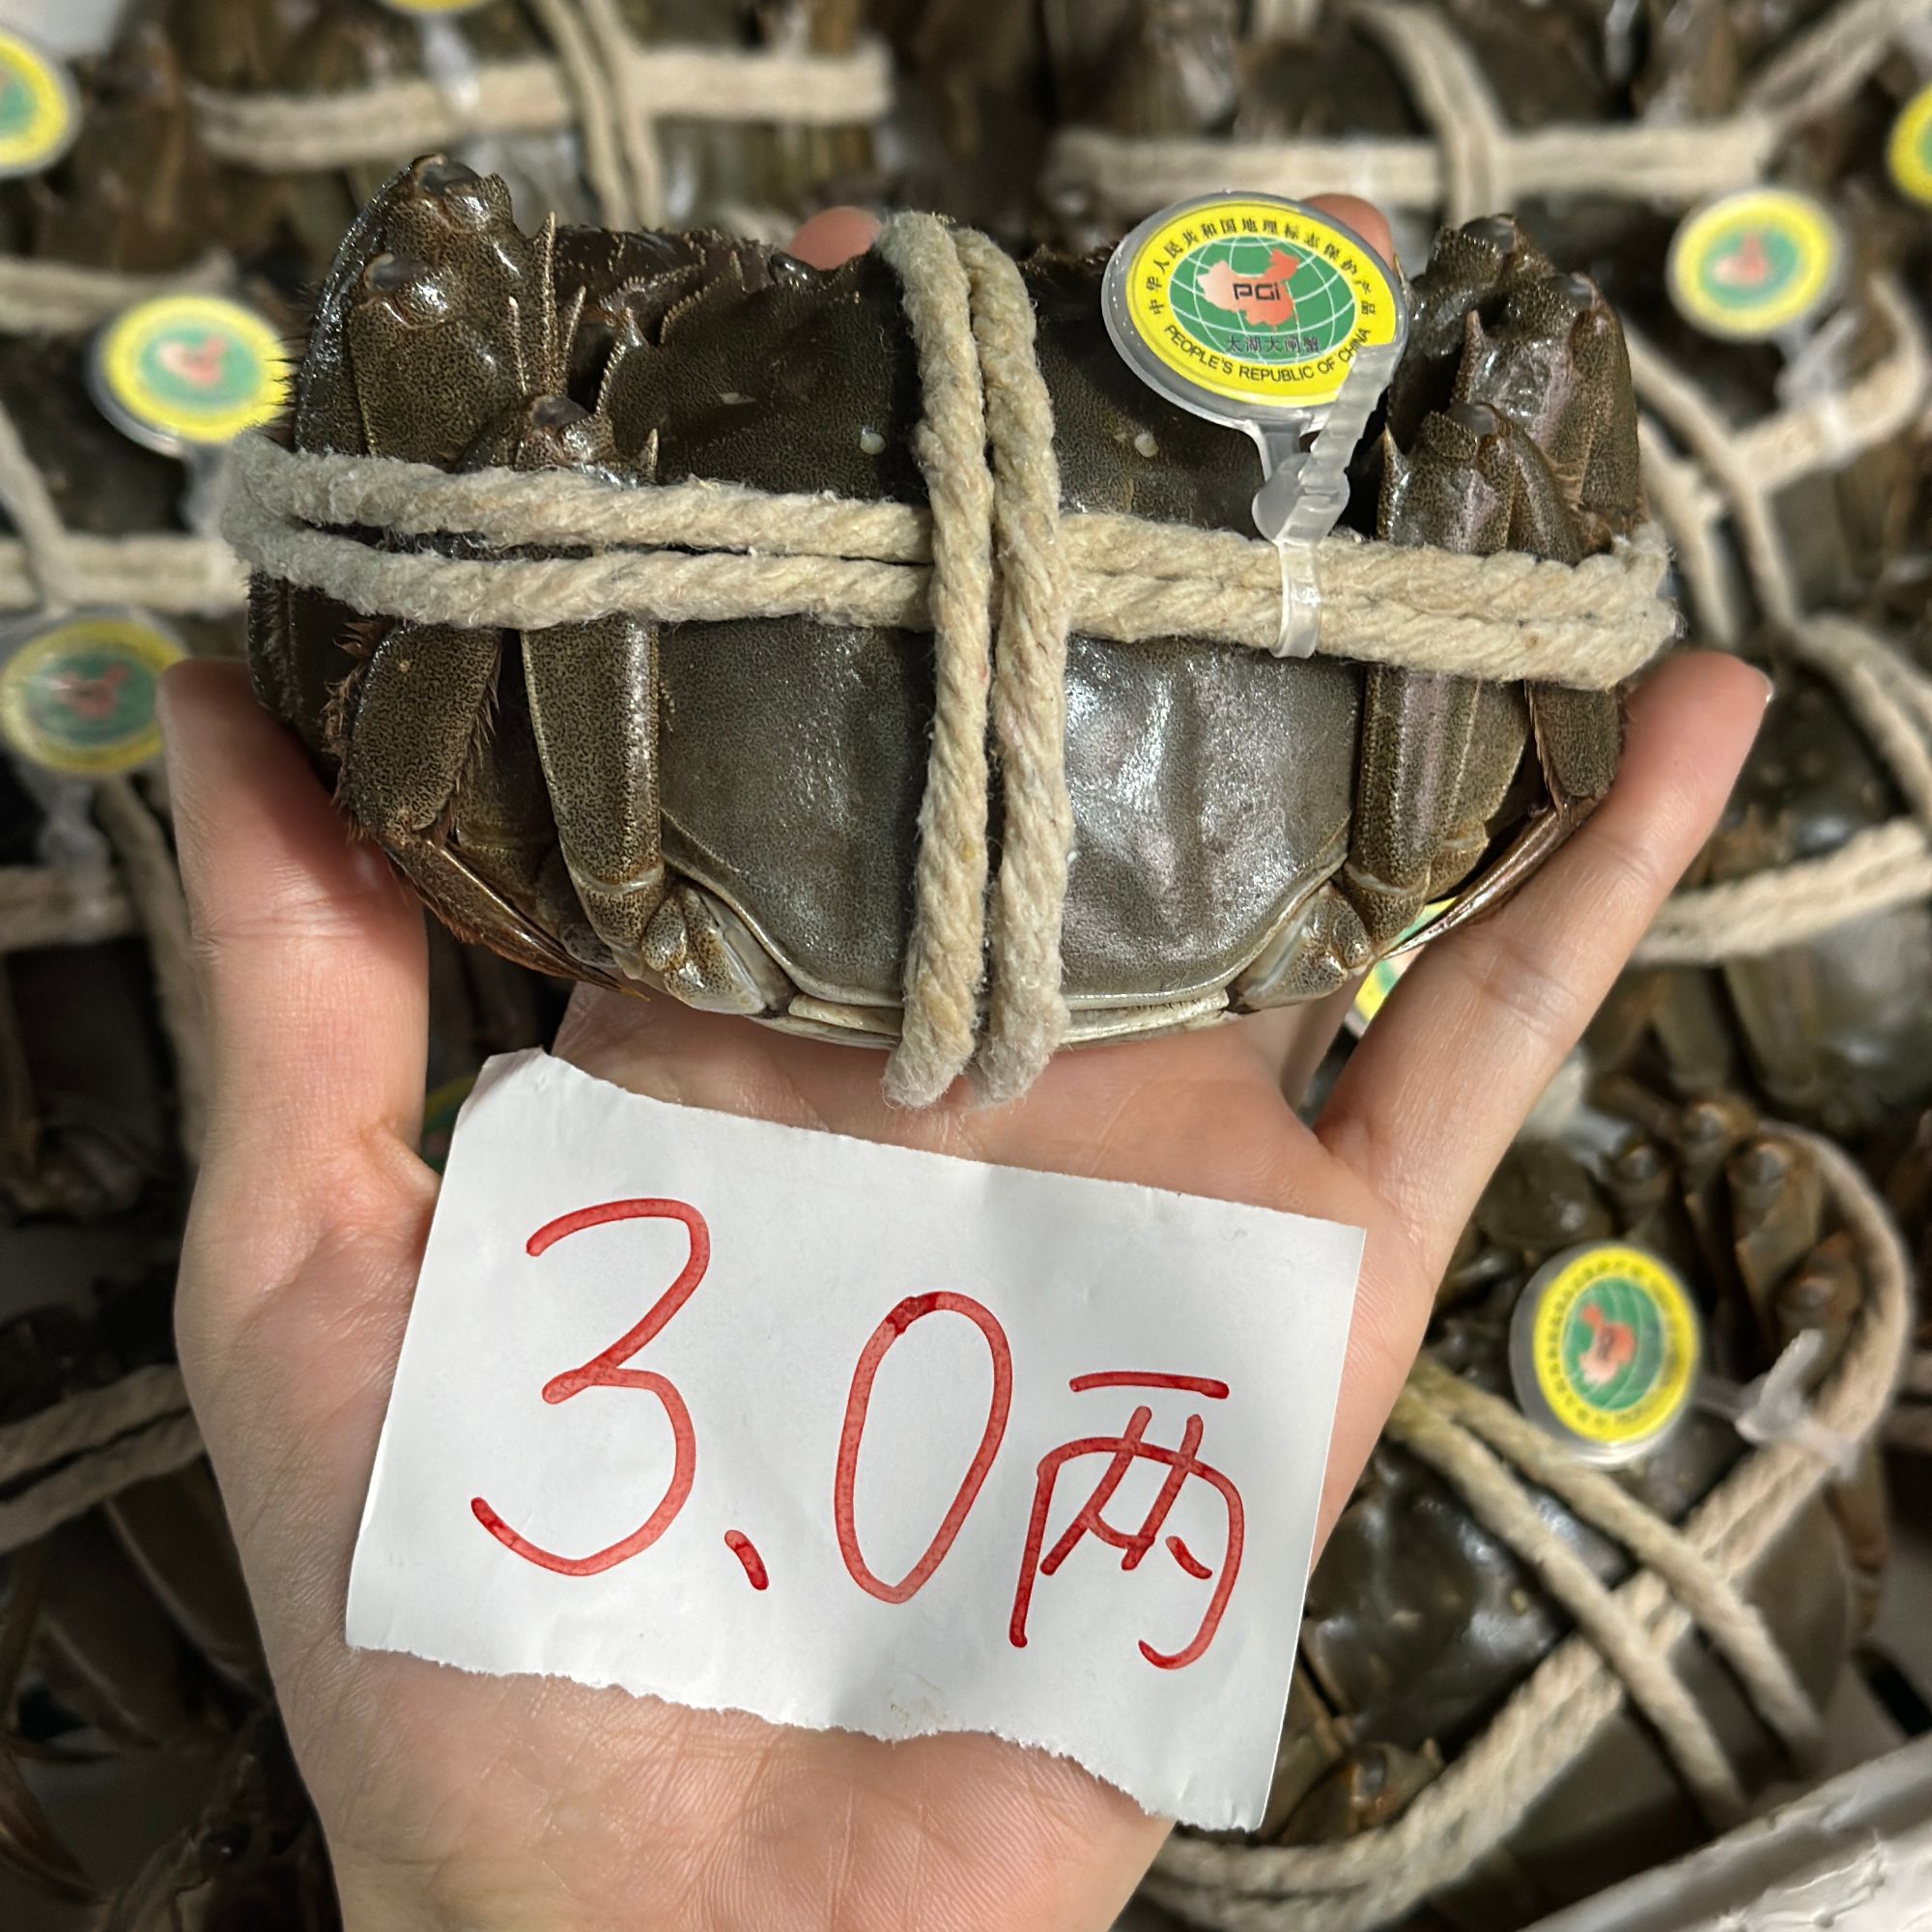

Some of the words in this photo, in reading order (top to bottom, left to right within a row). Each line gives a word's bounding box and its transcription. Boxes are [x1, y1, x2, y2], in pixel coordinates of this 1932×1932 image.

[1146, 218, 1376, 315] 中华人民共和国地理标志保护产品
[1164, 324, 1233, 375] PEOPLE'S
[1238, 366, 1315, 383] REPUBLIC
[1317, 357, 1336, 375] OF
[1338, 327, 1371, 363] CHINA
